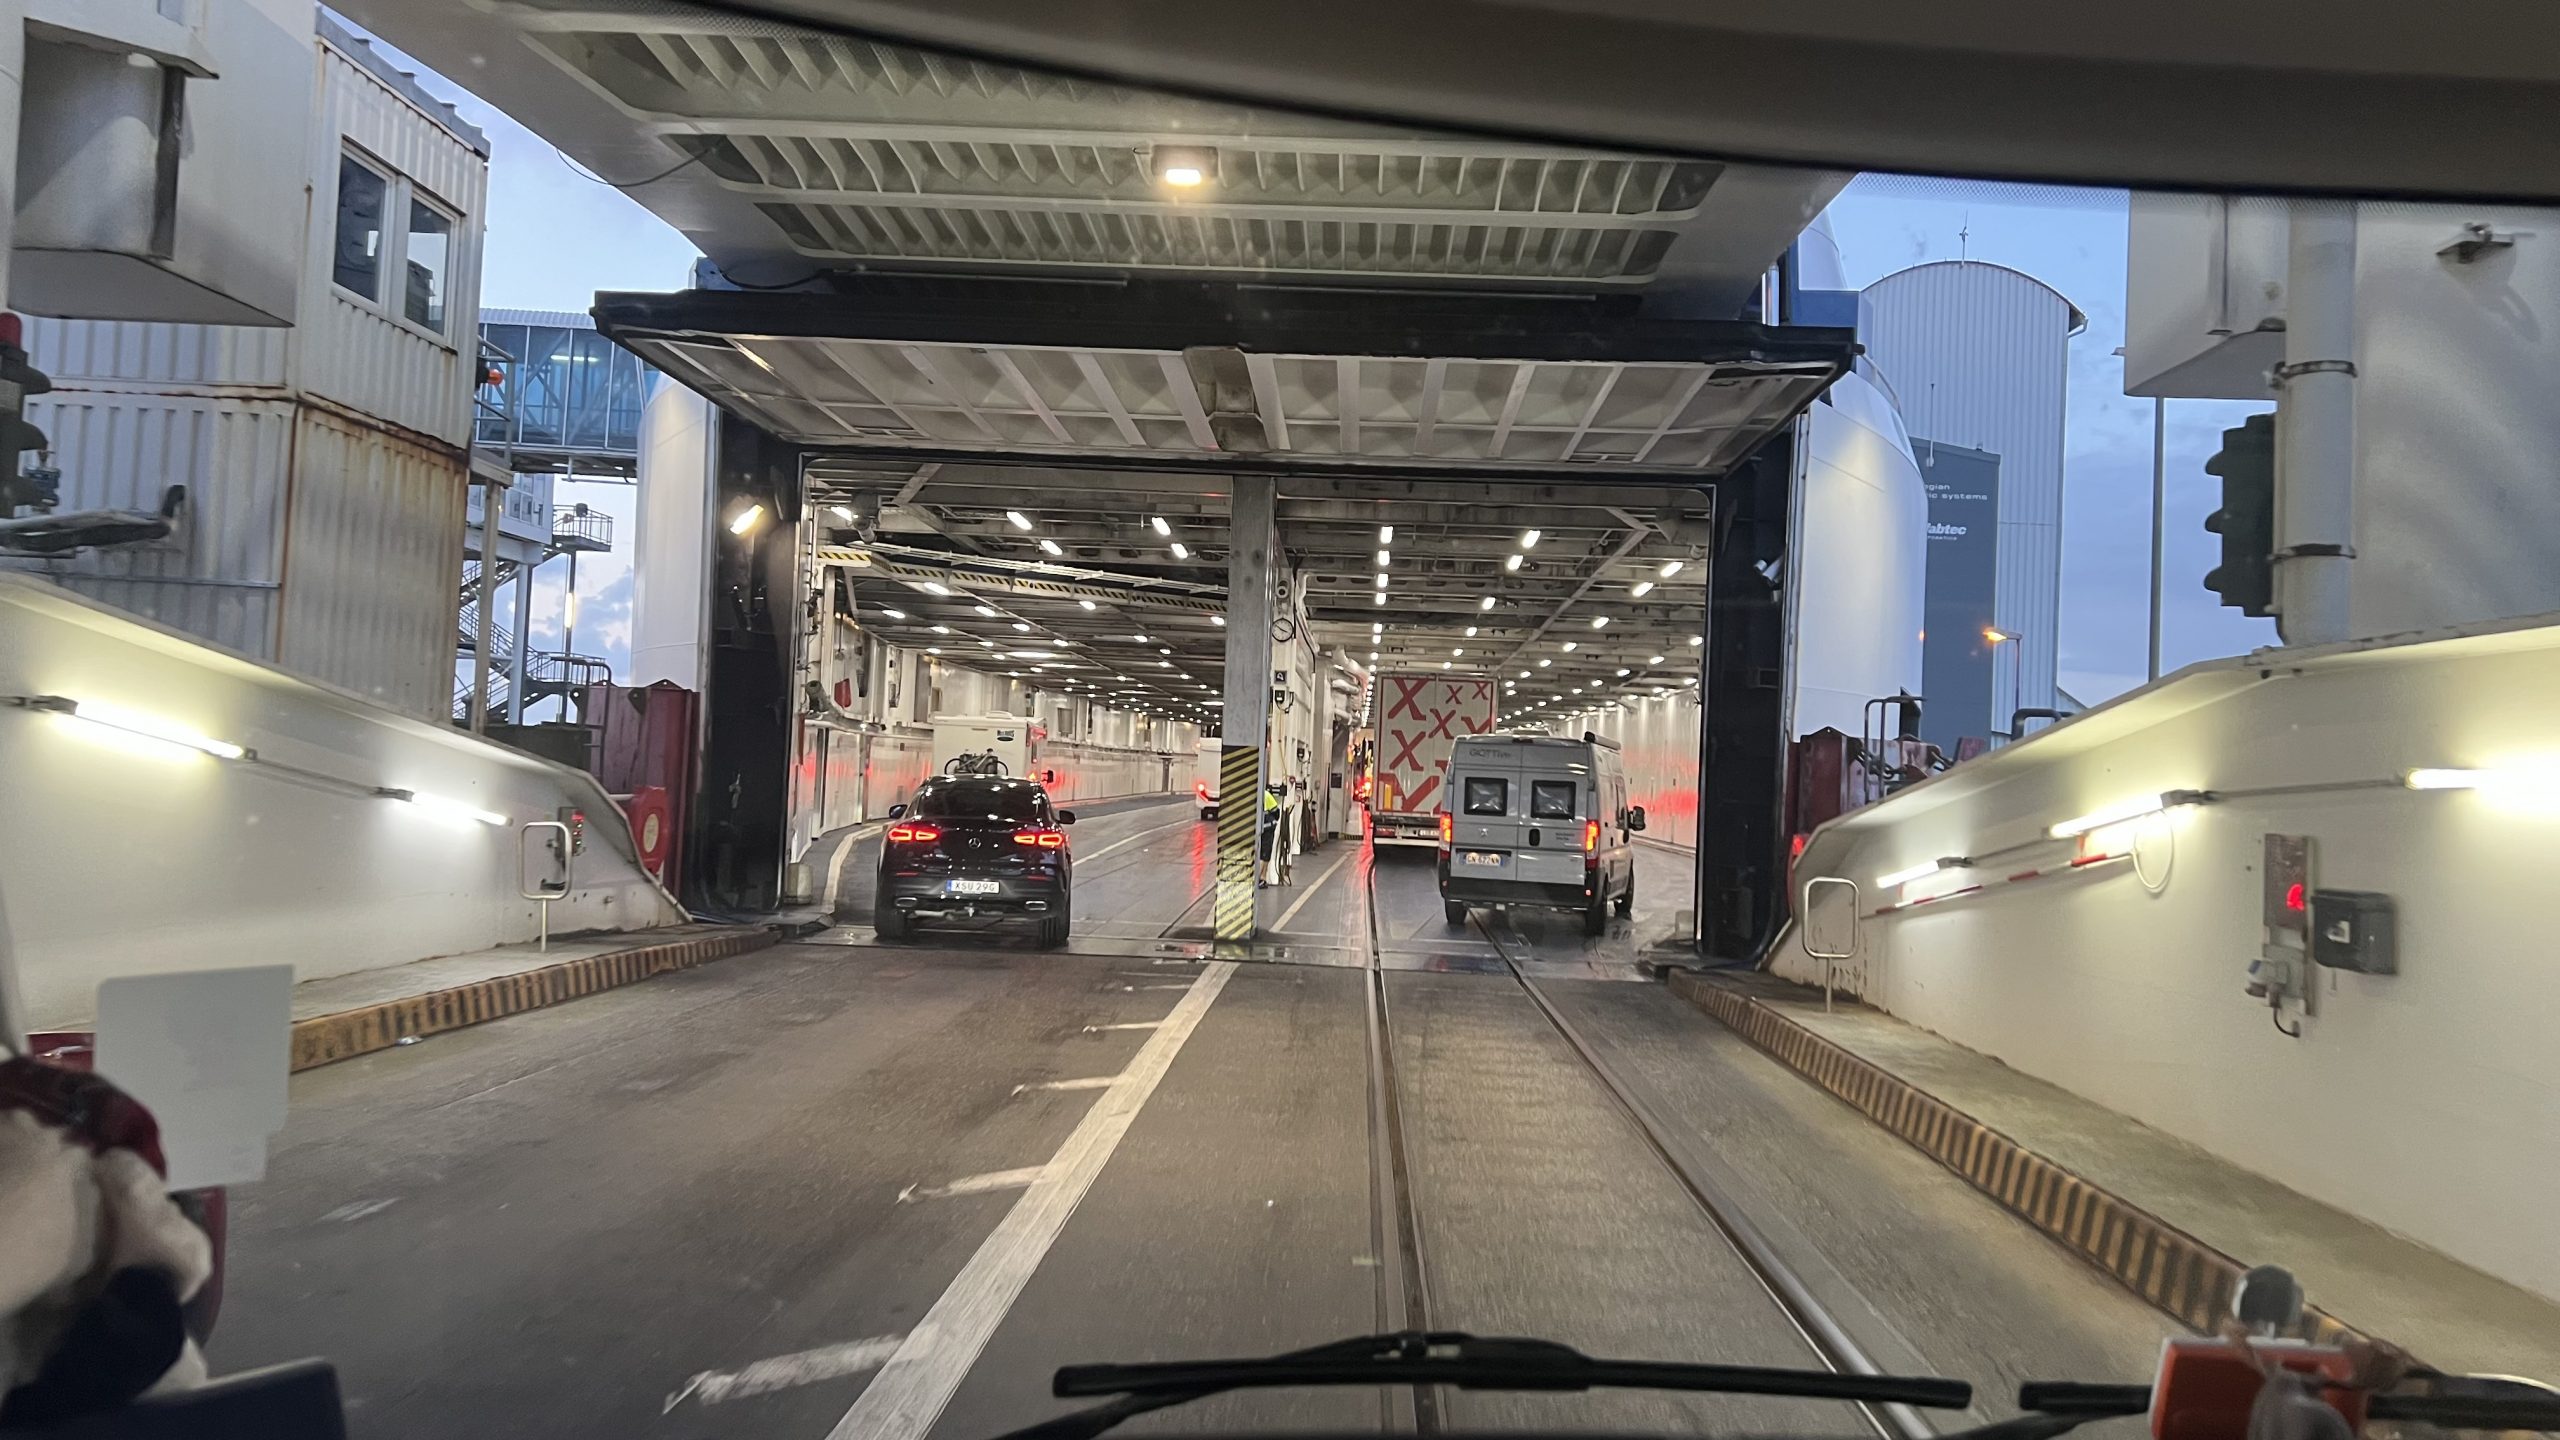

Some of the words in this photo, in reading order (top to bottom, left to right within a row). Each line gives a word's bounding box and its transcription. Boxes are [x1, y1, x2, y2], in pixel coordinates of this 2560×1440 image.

[1942, 493, 1988, 501] systems
[1928, 523, 1967, 535] abtec
[955, 881, 974, 890] XSU
